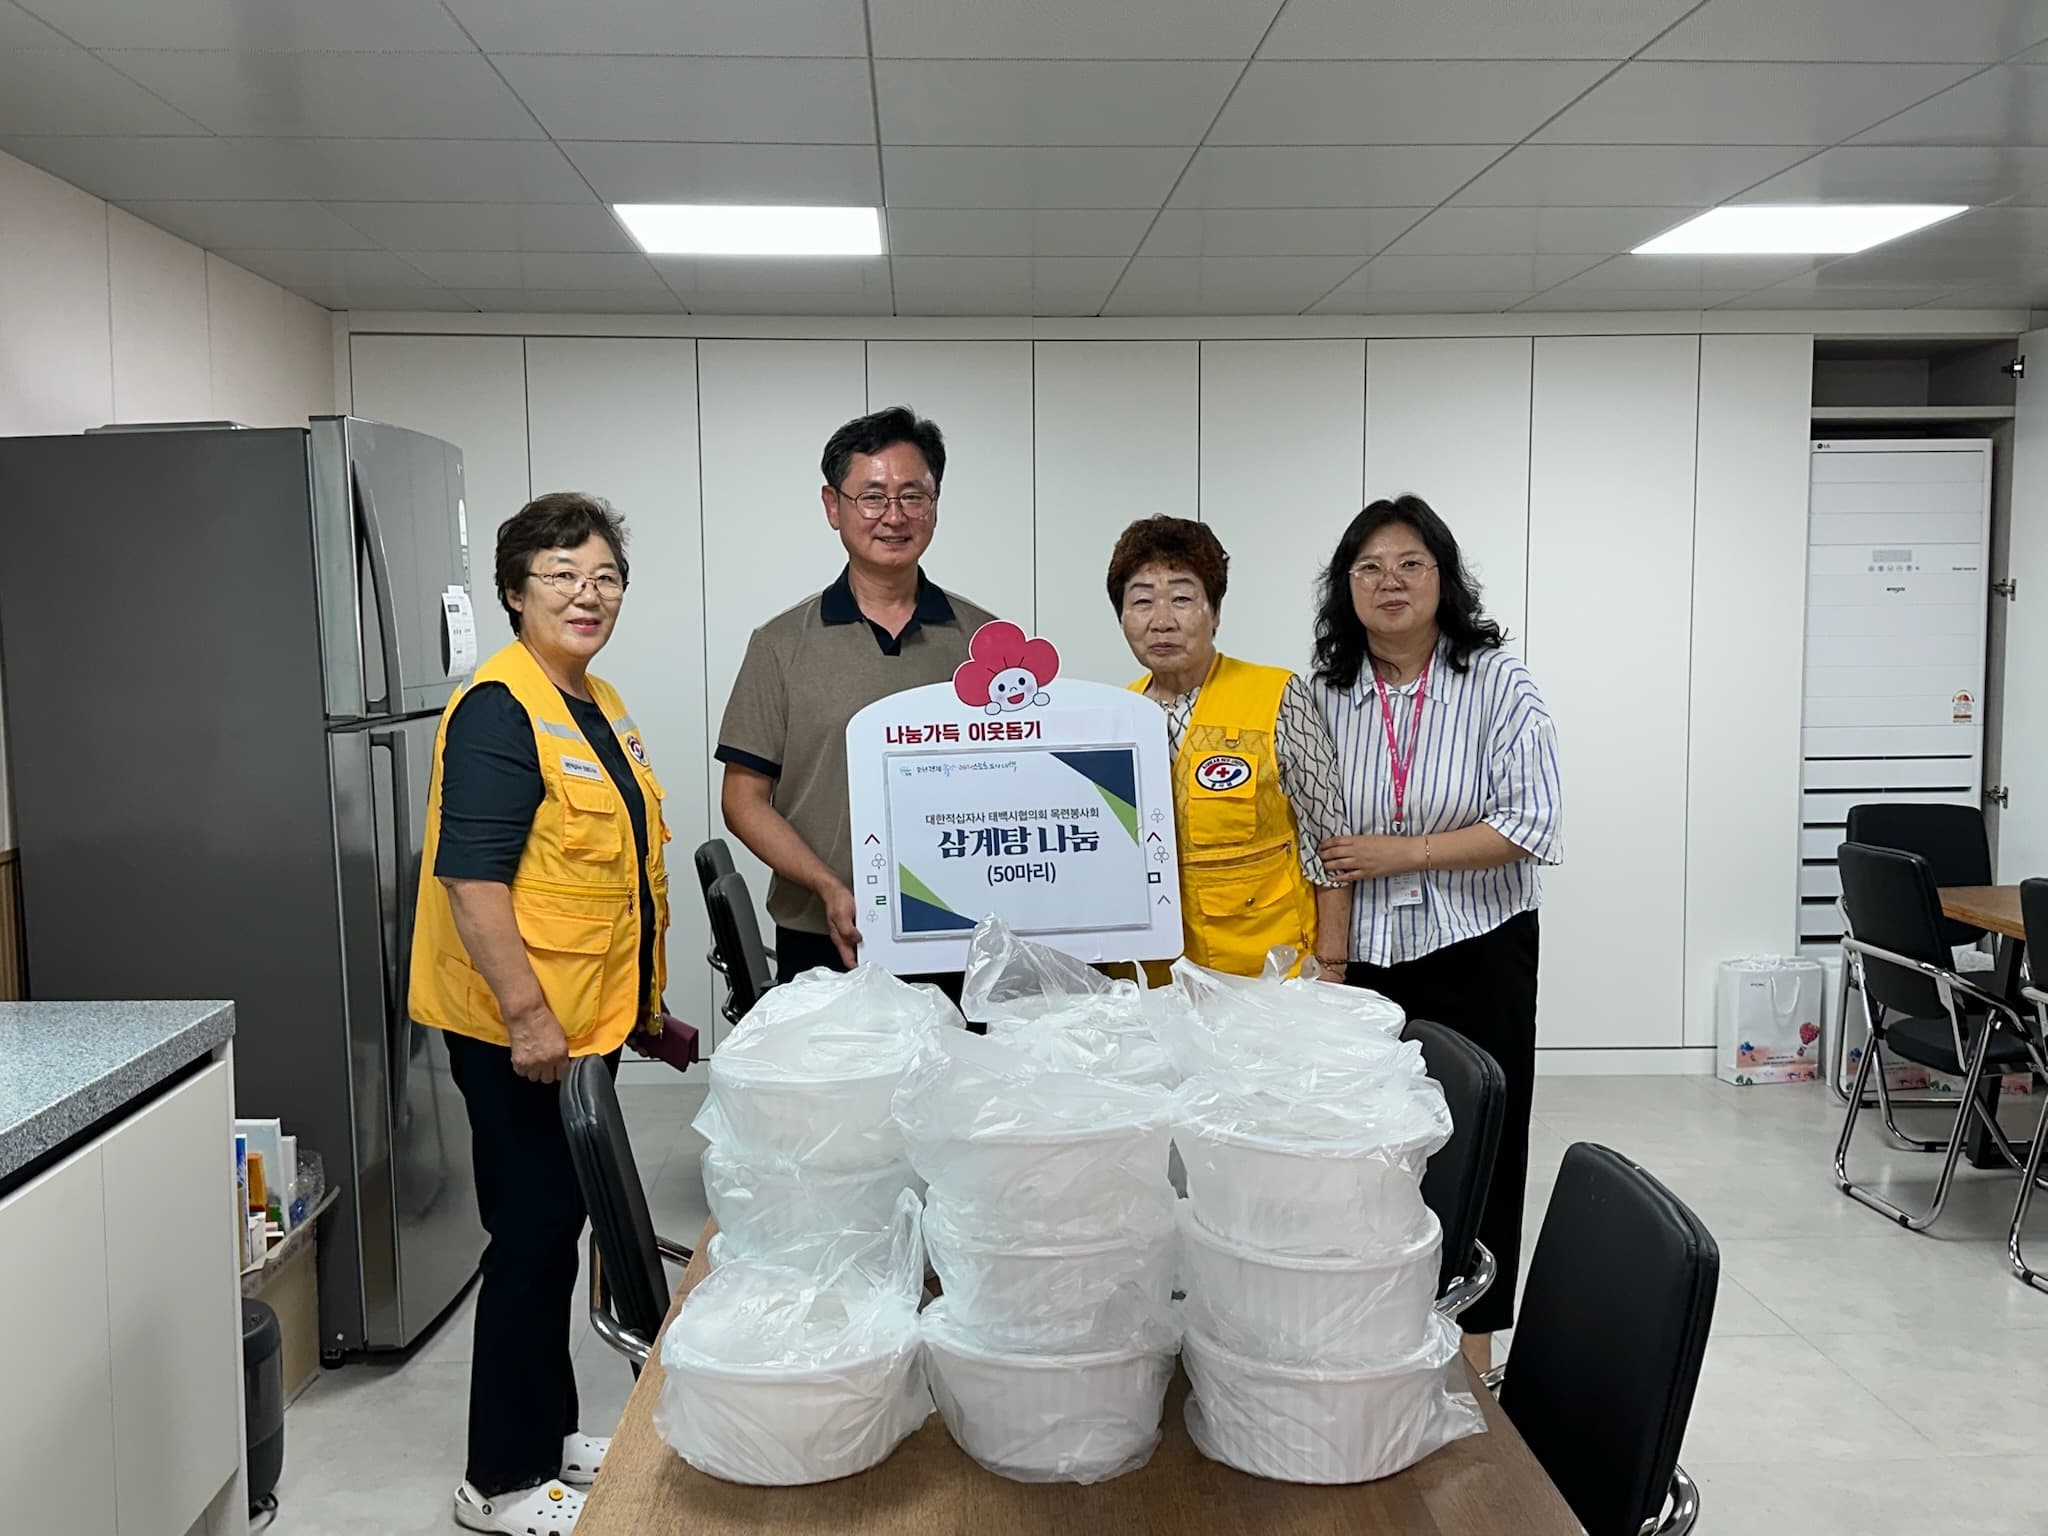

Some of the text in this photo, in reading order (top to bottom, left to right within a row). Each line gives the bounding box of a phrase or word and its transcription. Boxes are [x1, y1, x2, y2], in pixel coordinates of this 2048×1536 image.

[886, 720, 1041, 744] 나눔가득 이웃돕기
[925, 807, 1099, 825] 대한적십자사 태백시협의회 목련봉사회
[938, 824, 1099, 859] 삼계탕 나눔
[988, 861, 1056, 887] (50마리)
